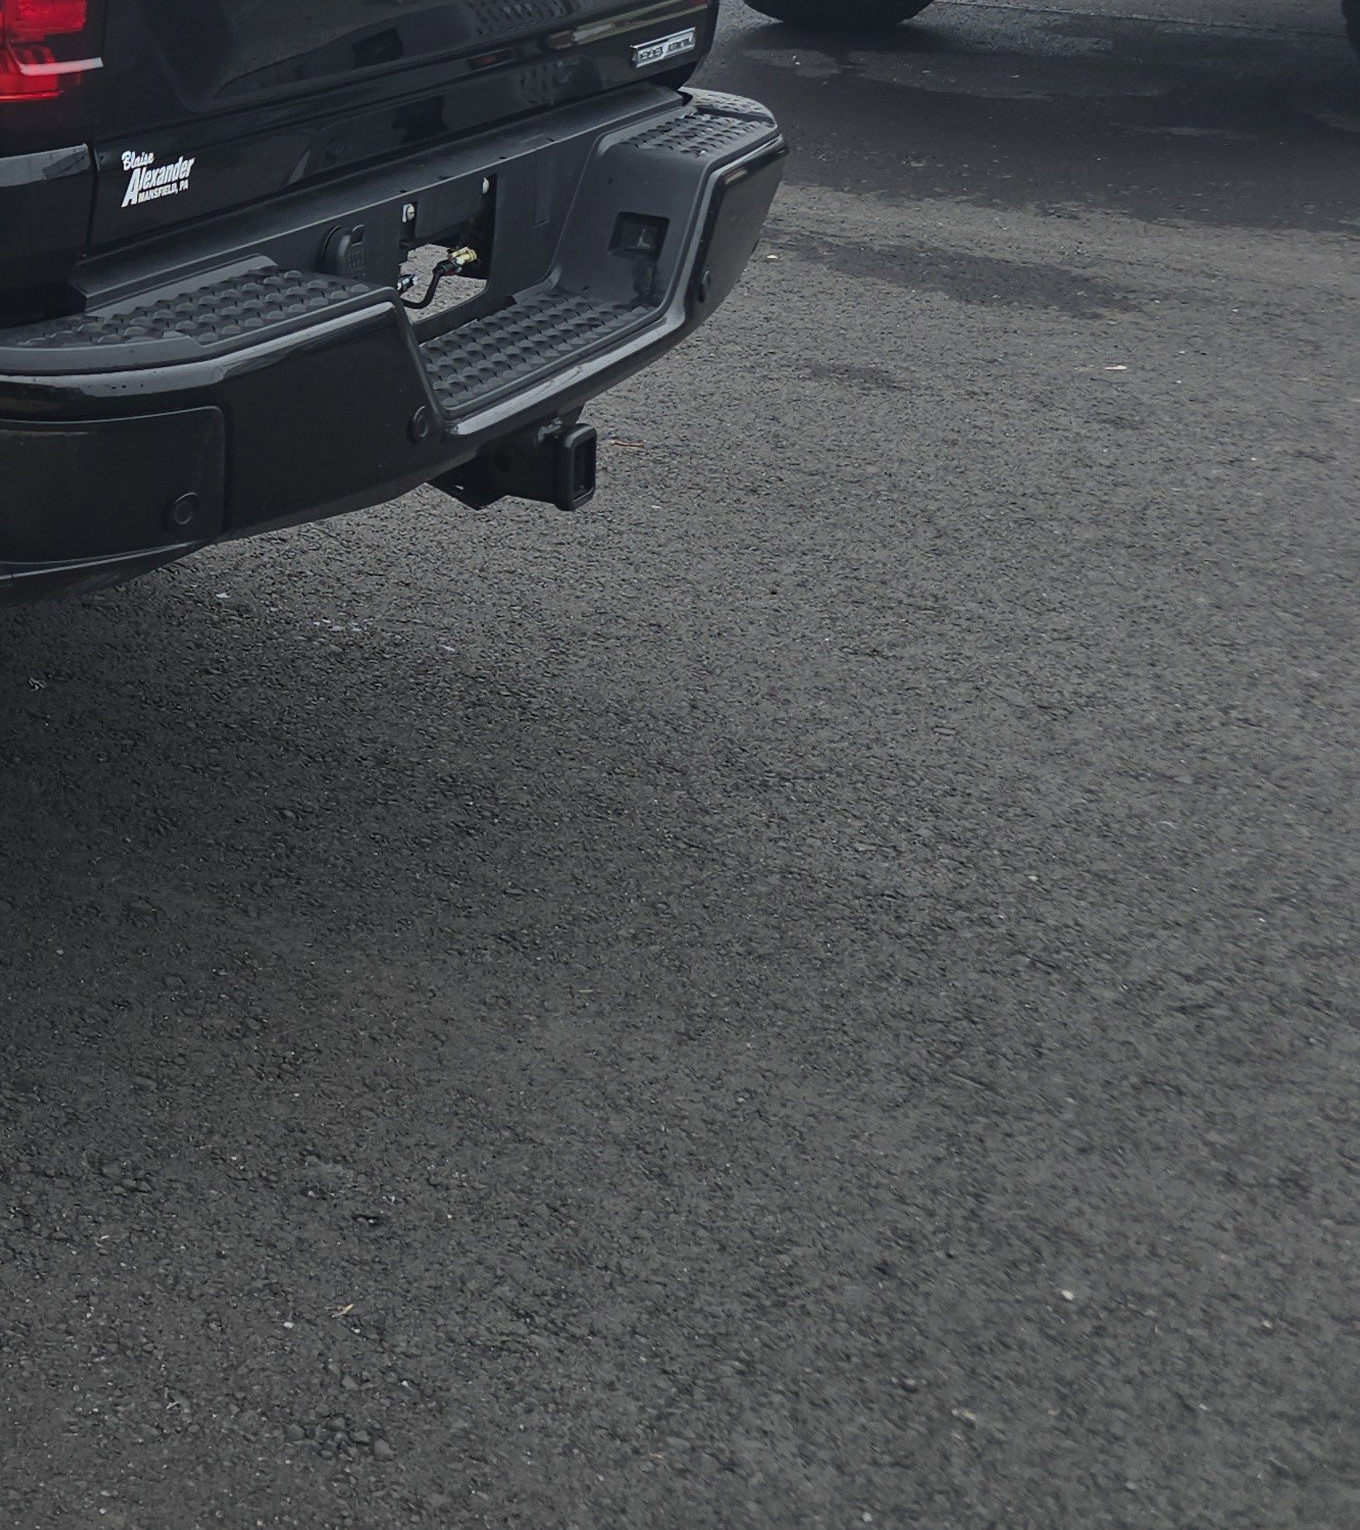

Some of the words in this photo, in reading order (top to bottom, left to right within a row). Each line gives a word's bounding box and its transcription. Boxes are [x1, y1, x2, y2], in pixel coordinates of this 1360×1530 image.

[121, 150, 155, 171] Blaise
[121, 155, 196, 208] Alexander
[179, 179, 189, 191] PA
